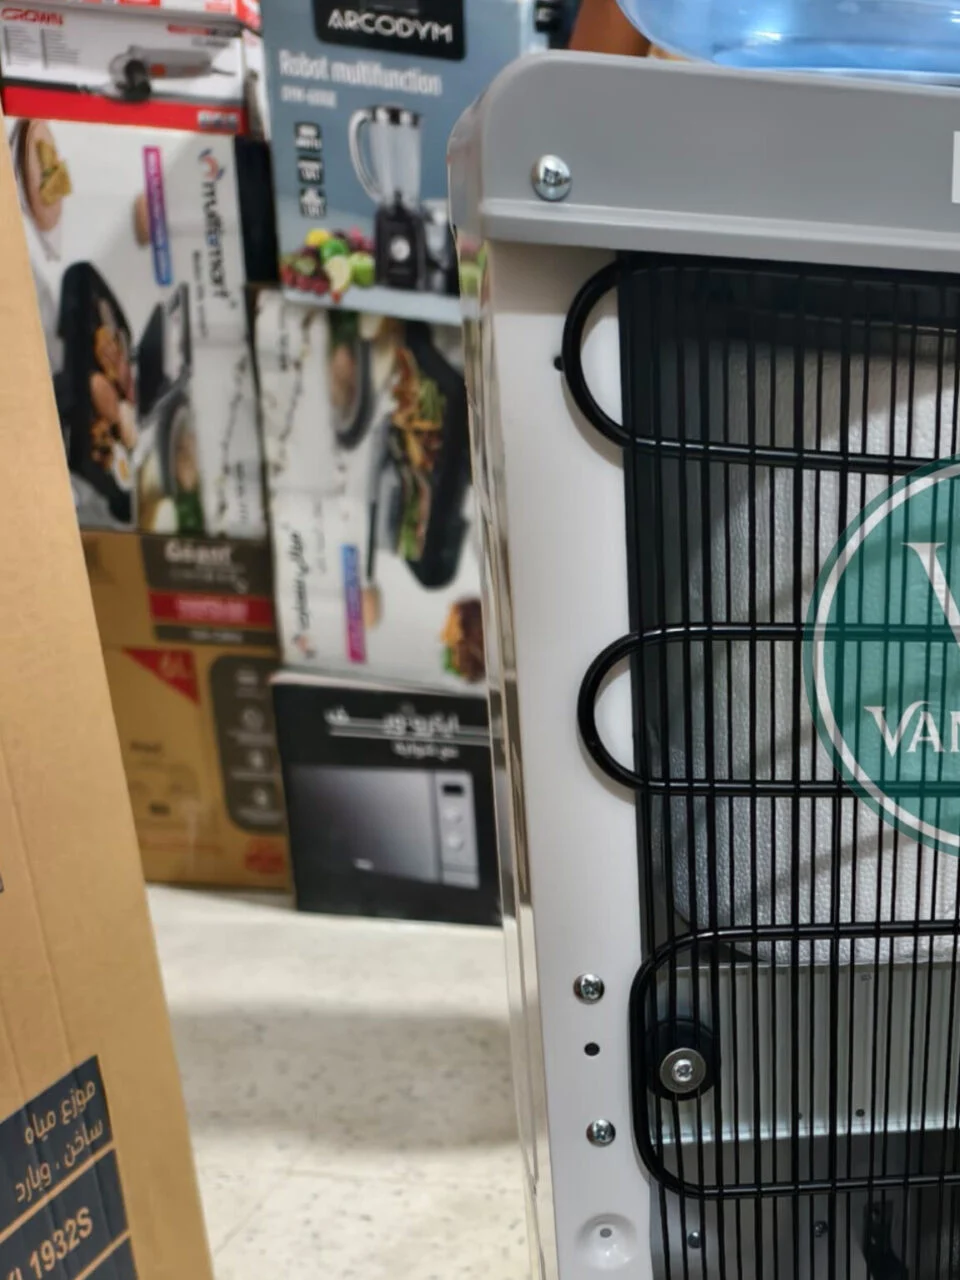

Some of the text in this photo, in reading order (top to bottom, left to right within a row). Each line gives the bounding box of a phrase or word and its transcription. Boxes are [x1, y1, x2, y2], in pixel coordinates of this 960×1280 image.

[328, 8, 453, 44] ARCODYM
[279, 49, 443, 97] Robot multifunction
[24, 1079, 96, 1145] موزع مياه
[64, 1118, 104, 1168] ساخن
[15, 1162, 52, 1203] وبارد
